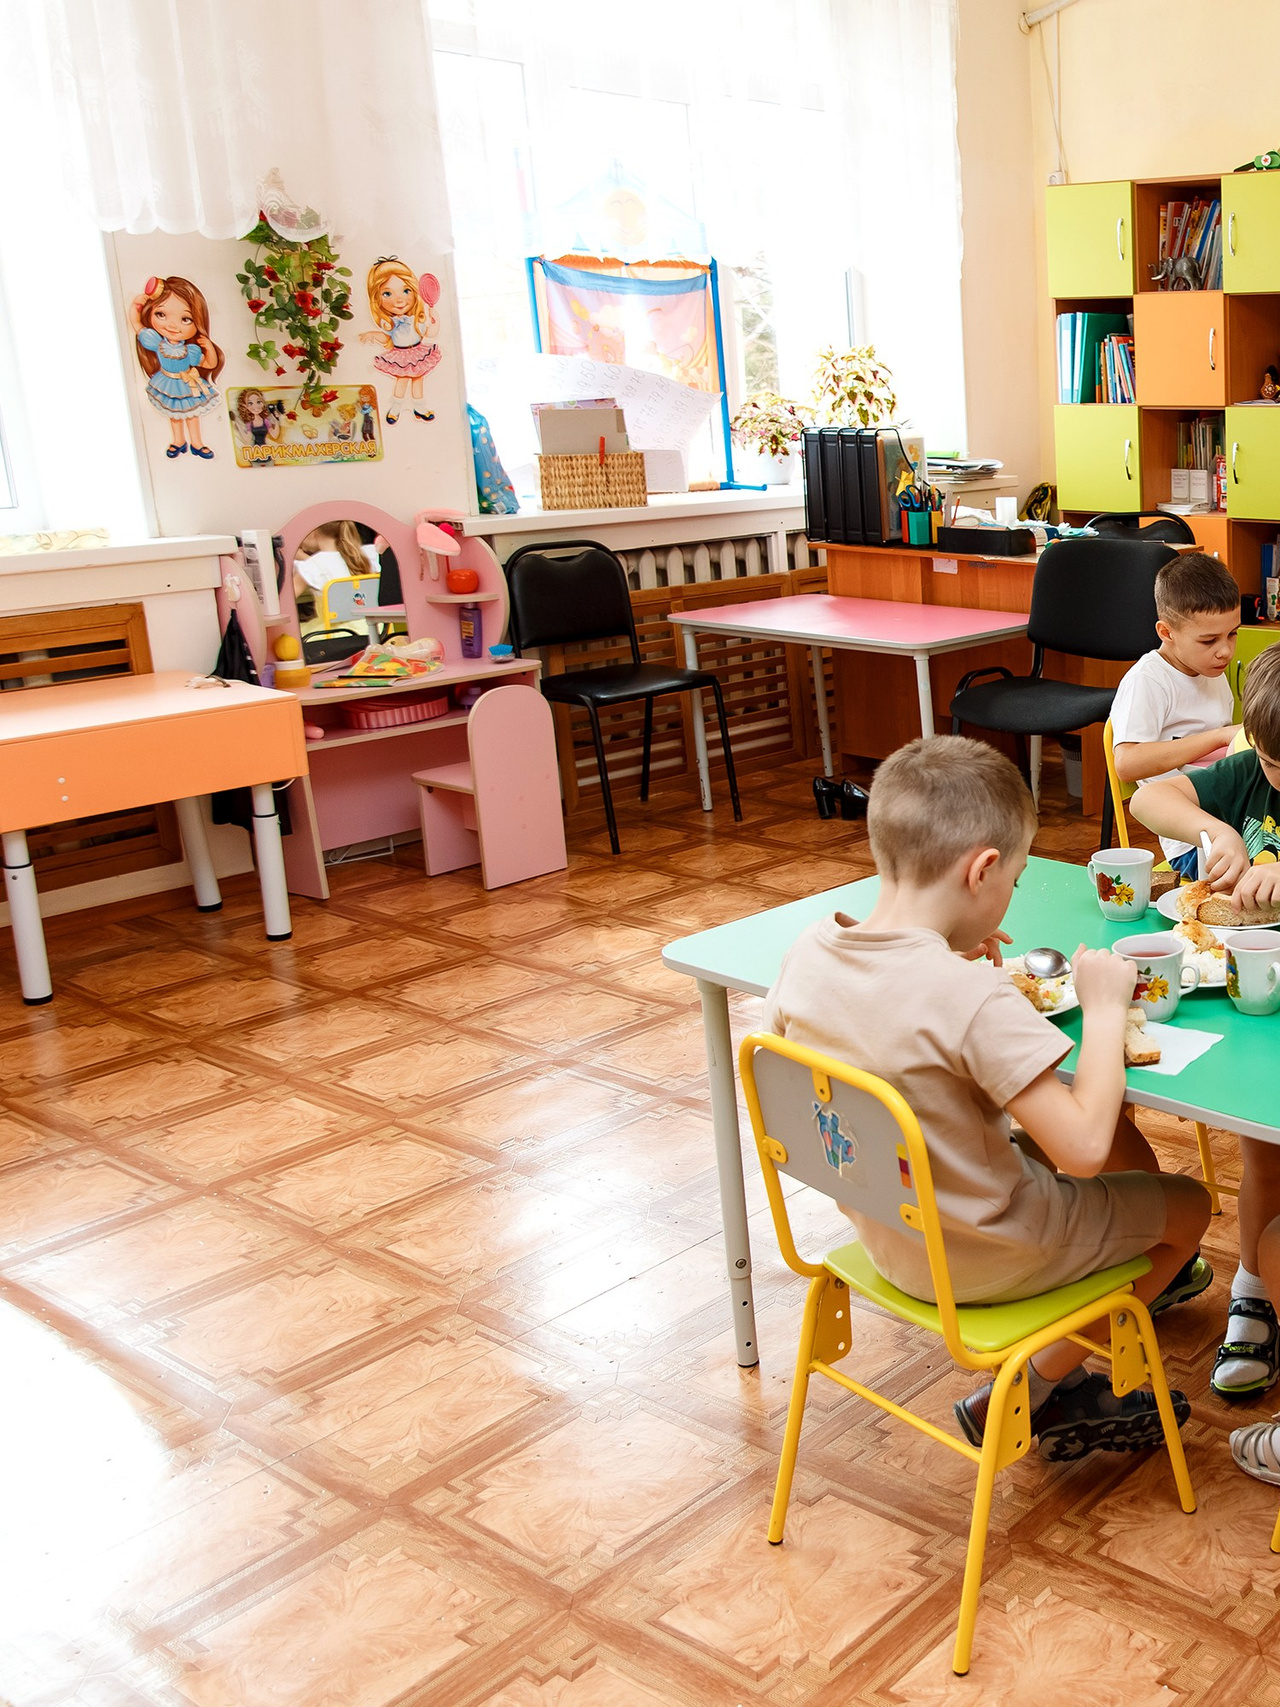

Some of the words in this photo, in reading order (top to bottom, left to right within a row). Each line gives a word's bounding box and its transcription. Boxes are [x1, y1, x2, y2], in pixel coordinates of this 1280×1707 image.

[580, 360, 596, 380] 50
[604, 365, 621, 380] 60
[241, 441, 378, 461] ПАРИКМАХЕРСКАЯ
